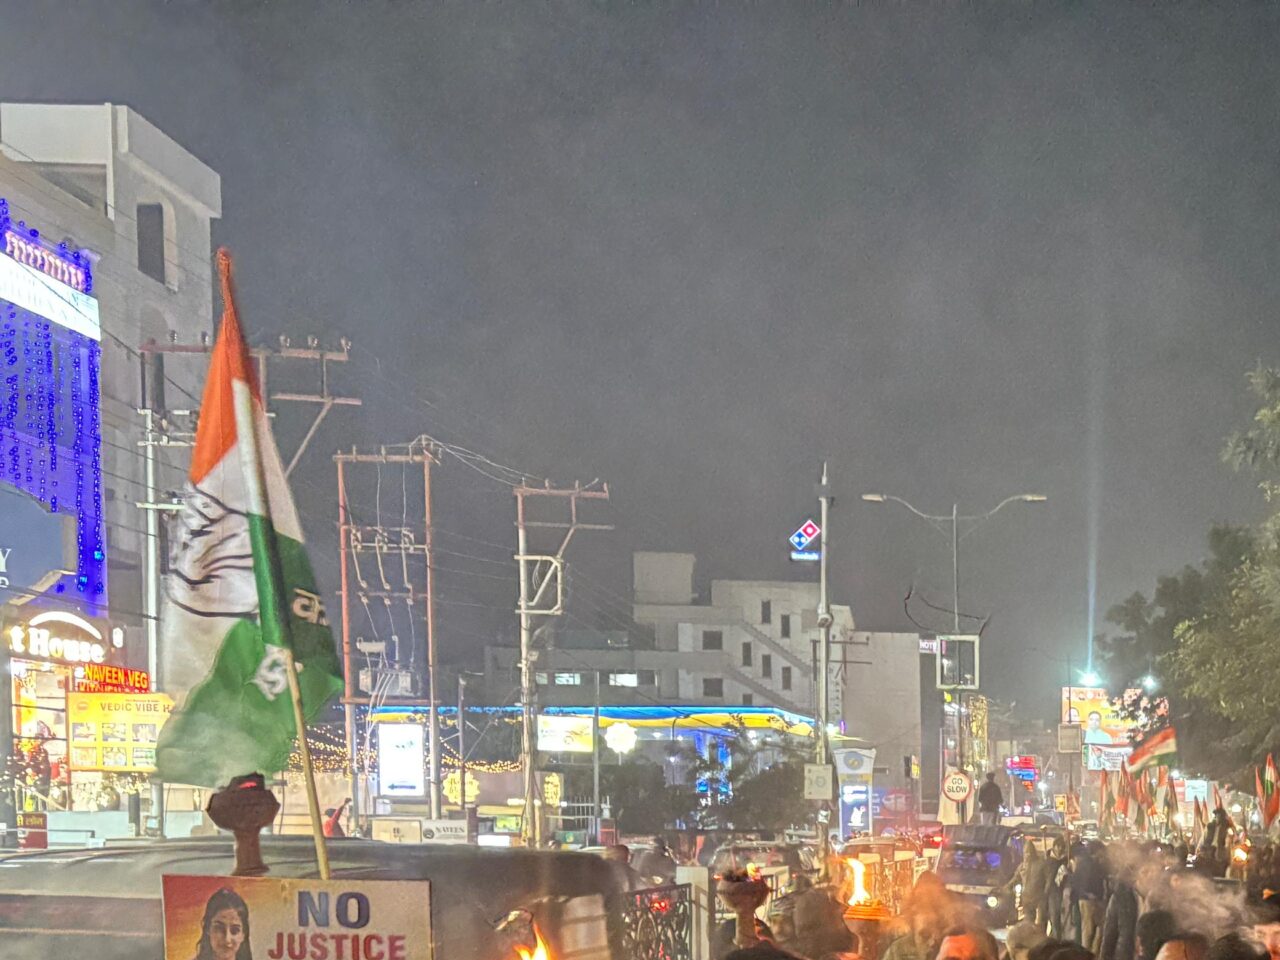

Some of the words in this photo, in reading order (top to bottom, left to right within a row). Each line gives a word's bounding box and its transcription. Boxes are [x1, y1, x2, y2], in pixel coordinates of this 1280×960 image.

[85, 663, 125, 685] NAVEEN
[127, 669, 149, 689] VEG
[100, 702, 132, 712] VEDIC
[135, 703, 160, 712] VIBE
[946, 785, 968, 793] SLOW
[297, 890, 371, 929] NO
